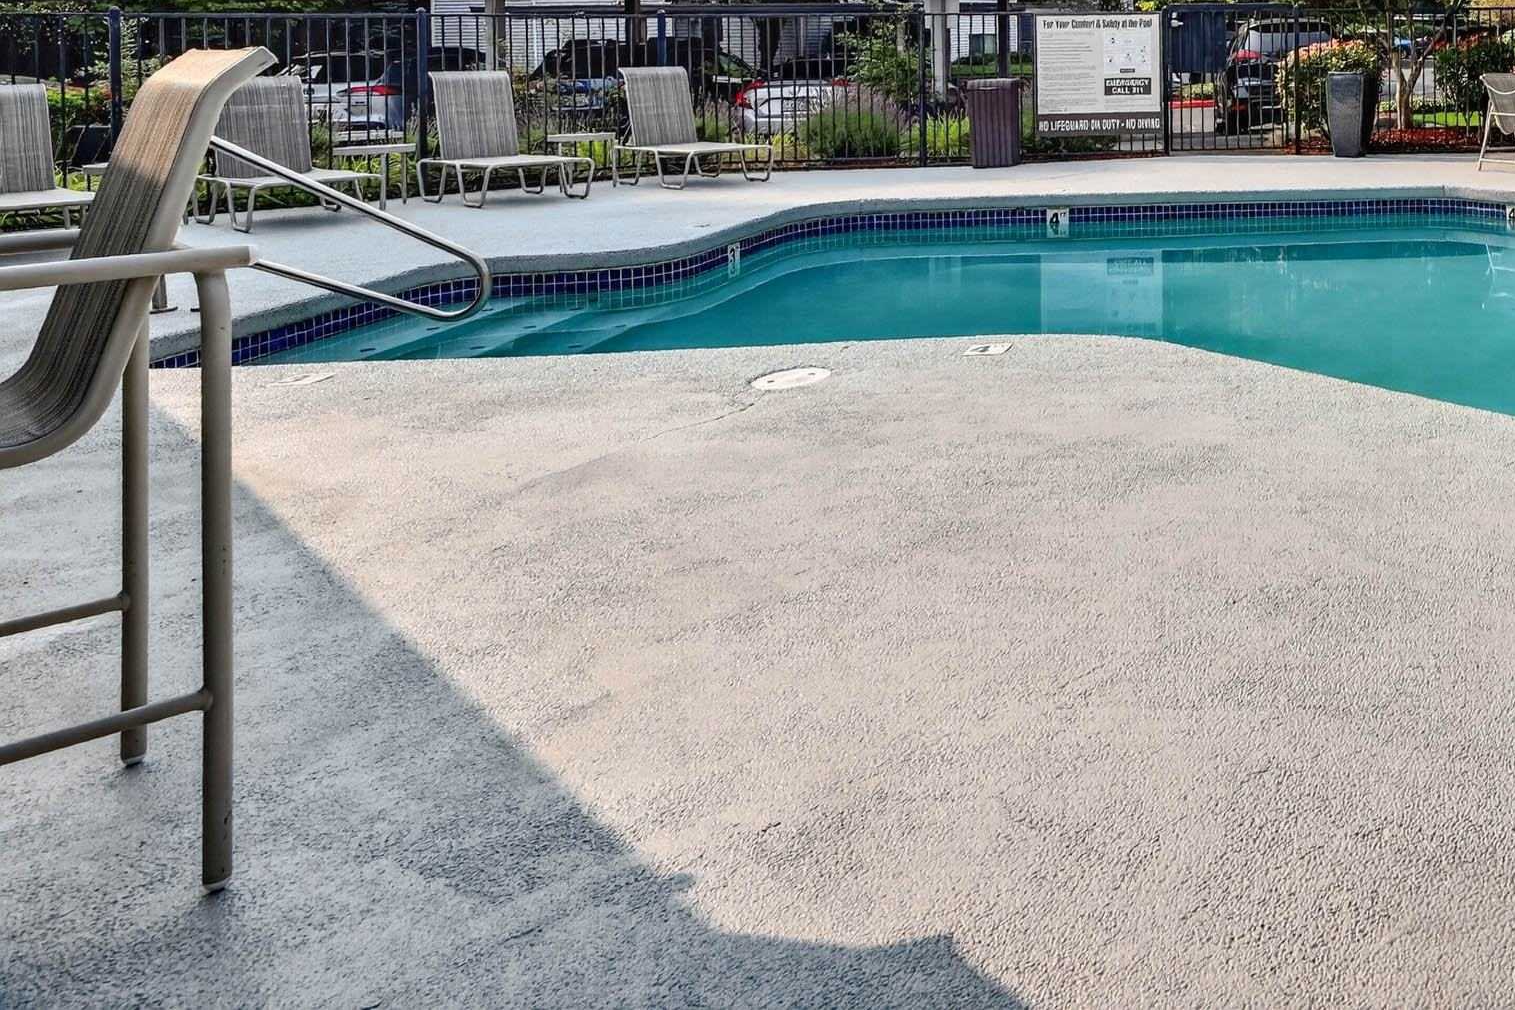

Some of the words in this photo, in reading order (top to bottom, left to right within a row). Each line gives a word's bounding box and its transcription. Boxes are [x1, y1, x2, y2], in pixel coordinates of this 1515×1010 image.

[1043, 20, 1053, 29] For
[1054, 20, 1070, 29] Your
[1102, 19, 1120, 30] Safety
[1127, 19, 1138, 28] the
[1139, 19, 1152, 28] Pool
[1106, 79, 1149, 87] EMERGENCY
[1039, 121, 1048, 131] NO
[1050, 120, 1088, 131] LIFEGUARD
[1091, 119, 1100, 130] ON
[1102, 118, 1120, 130] DUTY
[1126, 118, 1136, 130] NO
[1137, 117, 1160, 129] DIVING
